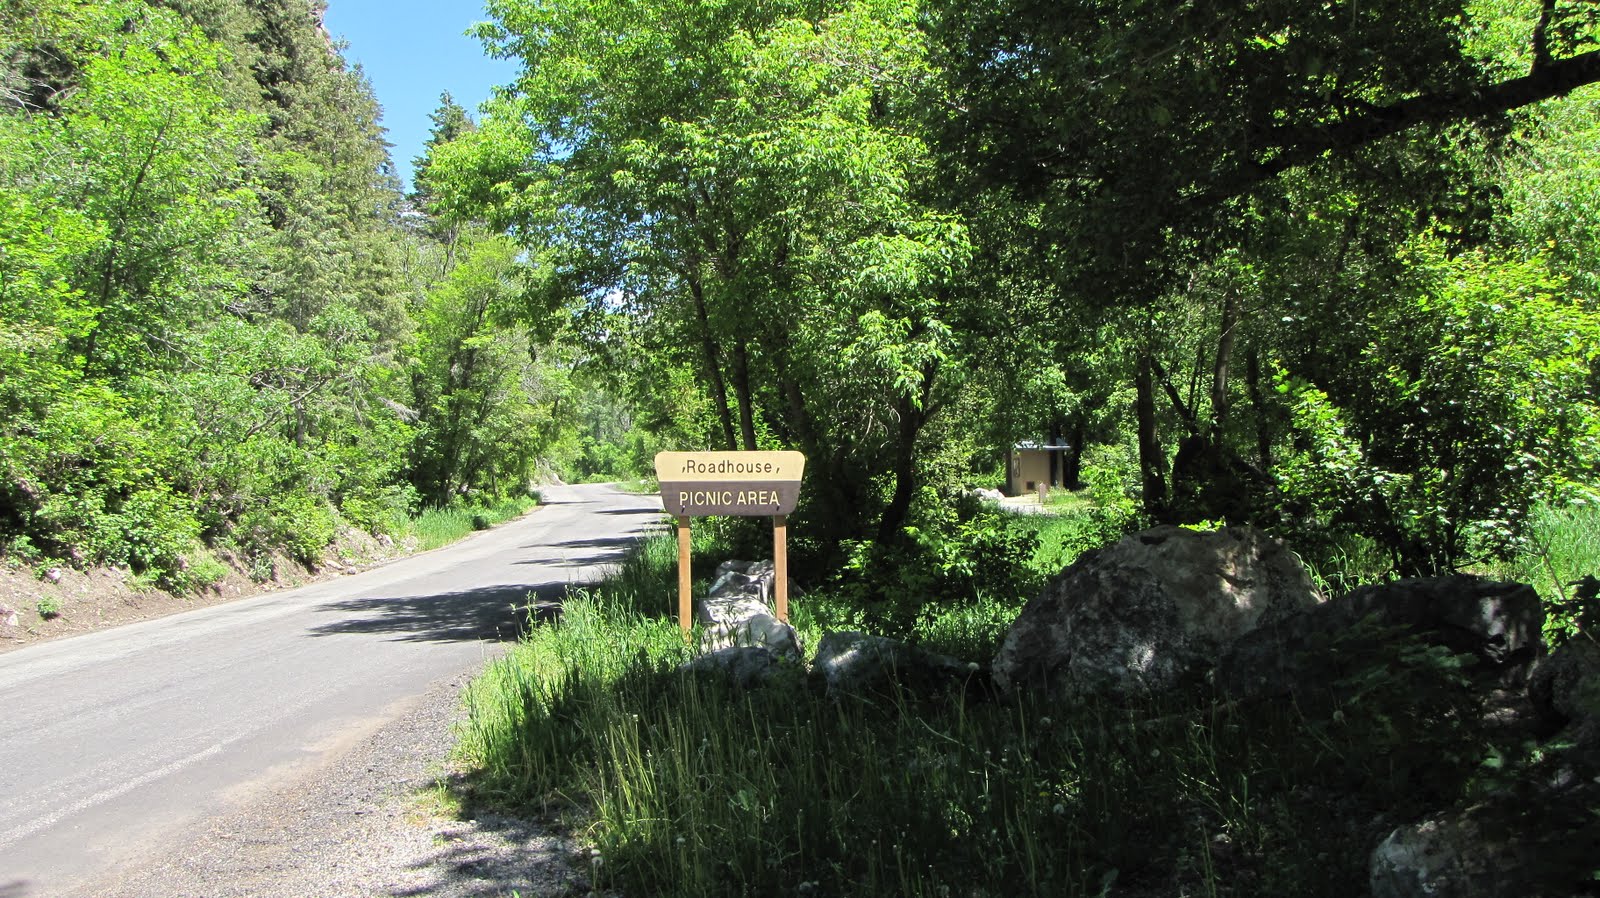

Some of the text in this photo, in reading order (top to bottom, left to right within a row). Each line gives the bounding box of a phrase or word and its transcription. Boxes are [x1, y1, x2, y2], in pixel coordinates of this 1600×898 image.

[686, 459, 772, 474] Roadhouse
[679, 490, 780, 506] PICNIC AREA
